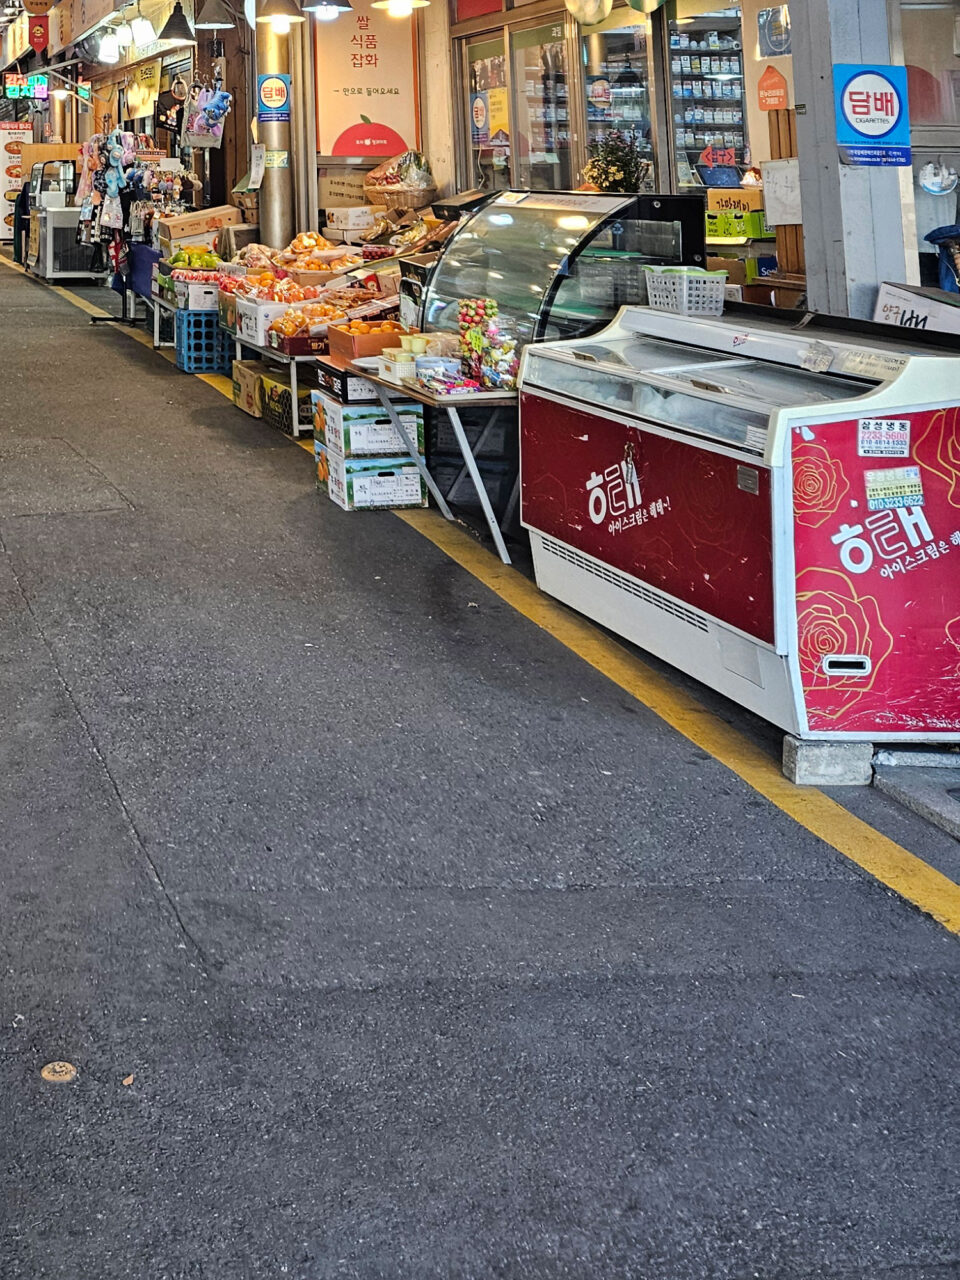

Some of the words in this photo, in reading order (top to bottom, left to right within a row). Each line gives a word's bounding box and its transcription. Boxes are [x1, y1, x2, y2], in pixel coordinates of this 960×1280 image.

[356, 15, 370, 30] 쌀
[350, 34, 378, 49] 식품
[350, 53, 379, 68] 잡화
[261, 85, 286, 99] 담배
[342, 87, 363, 96] 안으로
[366, 87, 400, 96] 들어오세요
[848, 90, 895, 117] 담배
[855, 117, 890, 125] CIGARETTES
[861, 421, 908, 432] 삼성냉동
[861, 431, 908, 440] 2233-5600
[608, 508, 649, 536] 아이스크림은
[880, 540, 950, 580] 아이스크림은
